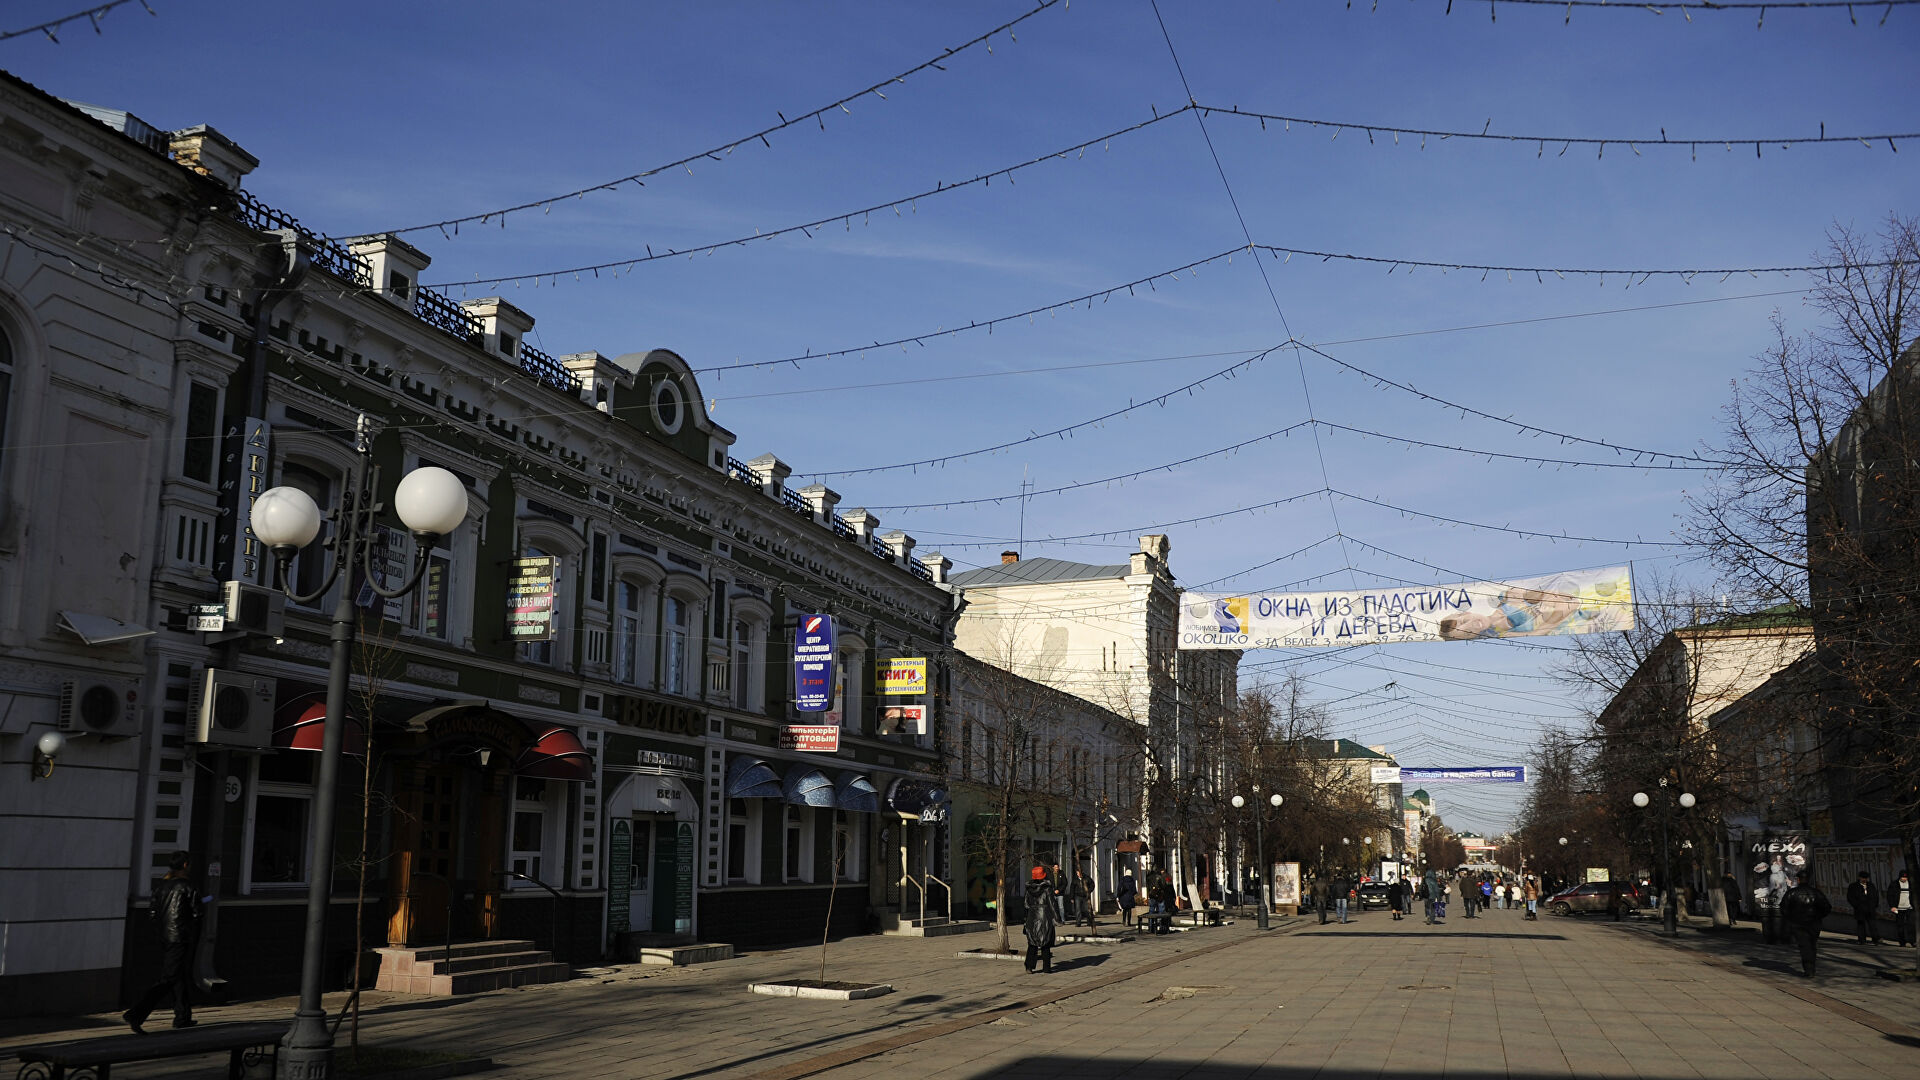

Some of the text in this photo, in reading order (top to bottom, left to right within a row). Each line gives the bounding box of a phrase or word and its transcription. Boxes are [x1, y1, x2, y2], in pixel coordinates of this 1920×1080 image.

[522, 567, 539, 575] РЕМОНТ
[510, 585, 550, 594] АКСЕСУАРЫ
[507, 596, 551, 607] ФОТО ЗА 5 МИНУТ
[1258, 588, 1472, 617] ОКНА ИЗ ПЛАСТИКА
[1312, 613, 1418, 639] И ДЕРЕВА
[805, 636, 821, 644] ЦЕНТР
[1183, 633, 1249, 645] ОКОШКО
[1284, 637, 1318, 646] ВЕЛЕС
[797, 644, 830, 653] ОПЕРАТИВНОЙ
[795, 653, 832, 662] БУХГАЛТЕРСКОЙ
[877, 659, 925, 667] КОМПЬЮТЕРНЫЕ
[877, 669, 916, 681] КНИГИ
[876, 685, 925, 693] РАДИОТЕХНИЧЕСКИЕ
[620, 695, 703, 737] ВЕЛЕС
[1412, 770, 1442, 779] Вклады
[1491, 770, 1516, 778] банке
[1751, 842, 1806, 853] МЕХА
